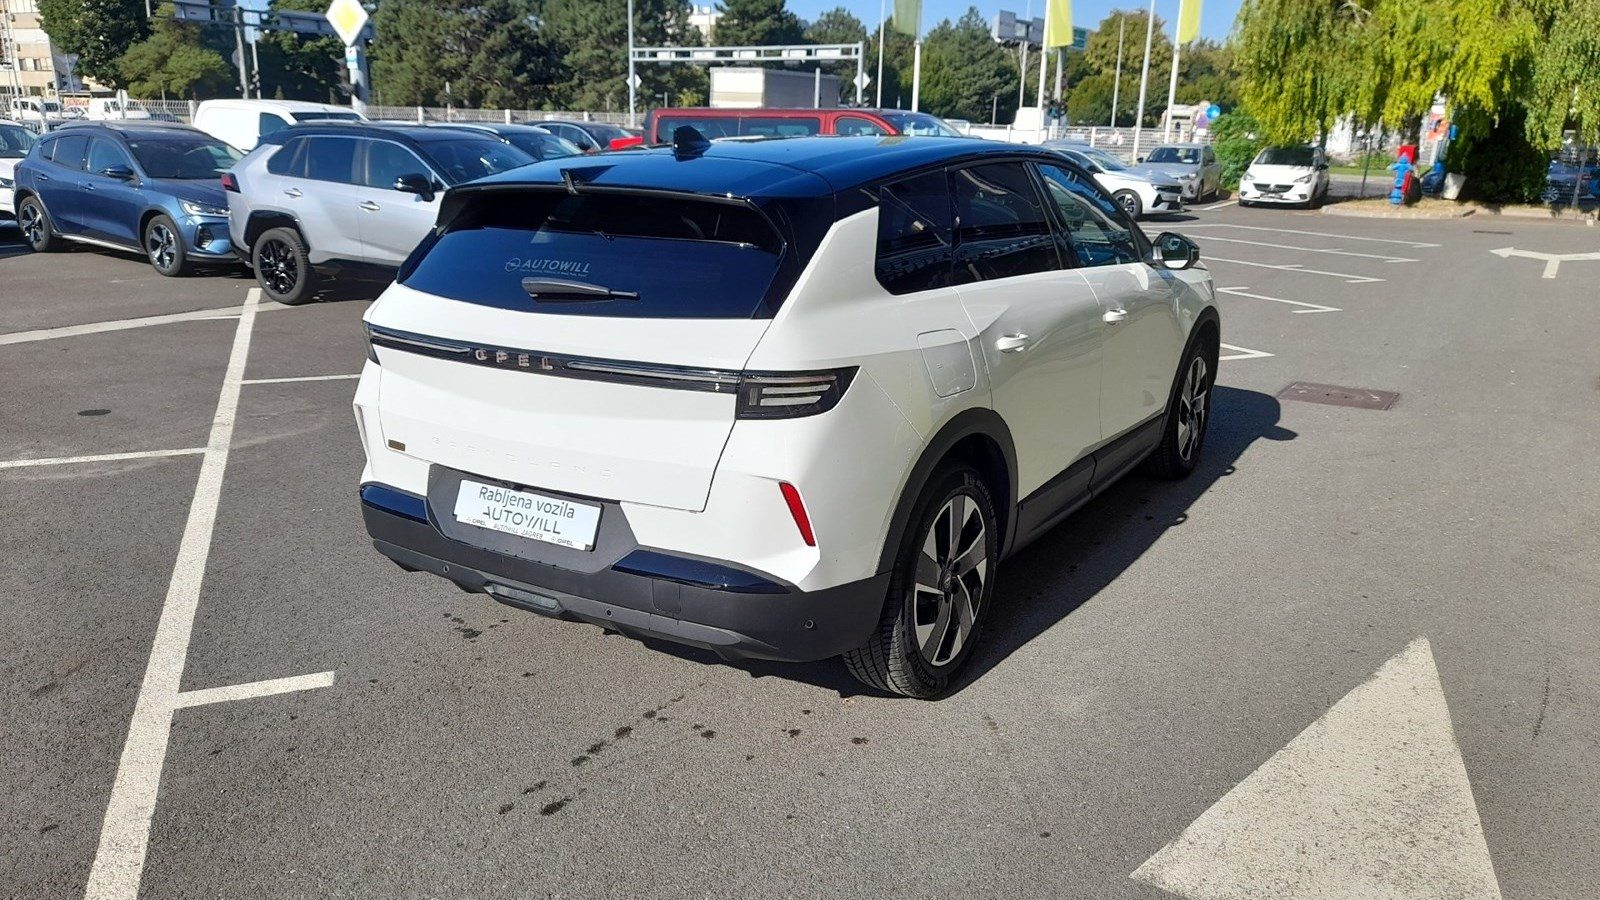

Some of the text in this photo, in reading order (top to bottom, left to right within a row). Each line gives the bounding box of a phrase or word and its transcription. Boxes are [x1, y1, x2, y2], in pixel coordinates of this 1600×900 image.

[522, 259, 591, 274] AUTOWILL
[475, 347, 553, 370] OPEL
[478, 486, 574, 520] Rabljena vozila
[482, 506, 561, 535] AUTOWILL
[493, 524, 519, 535] AUTOWILL
[521, 530, 544, 540] ZAGREB
